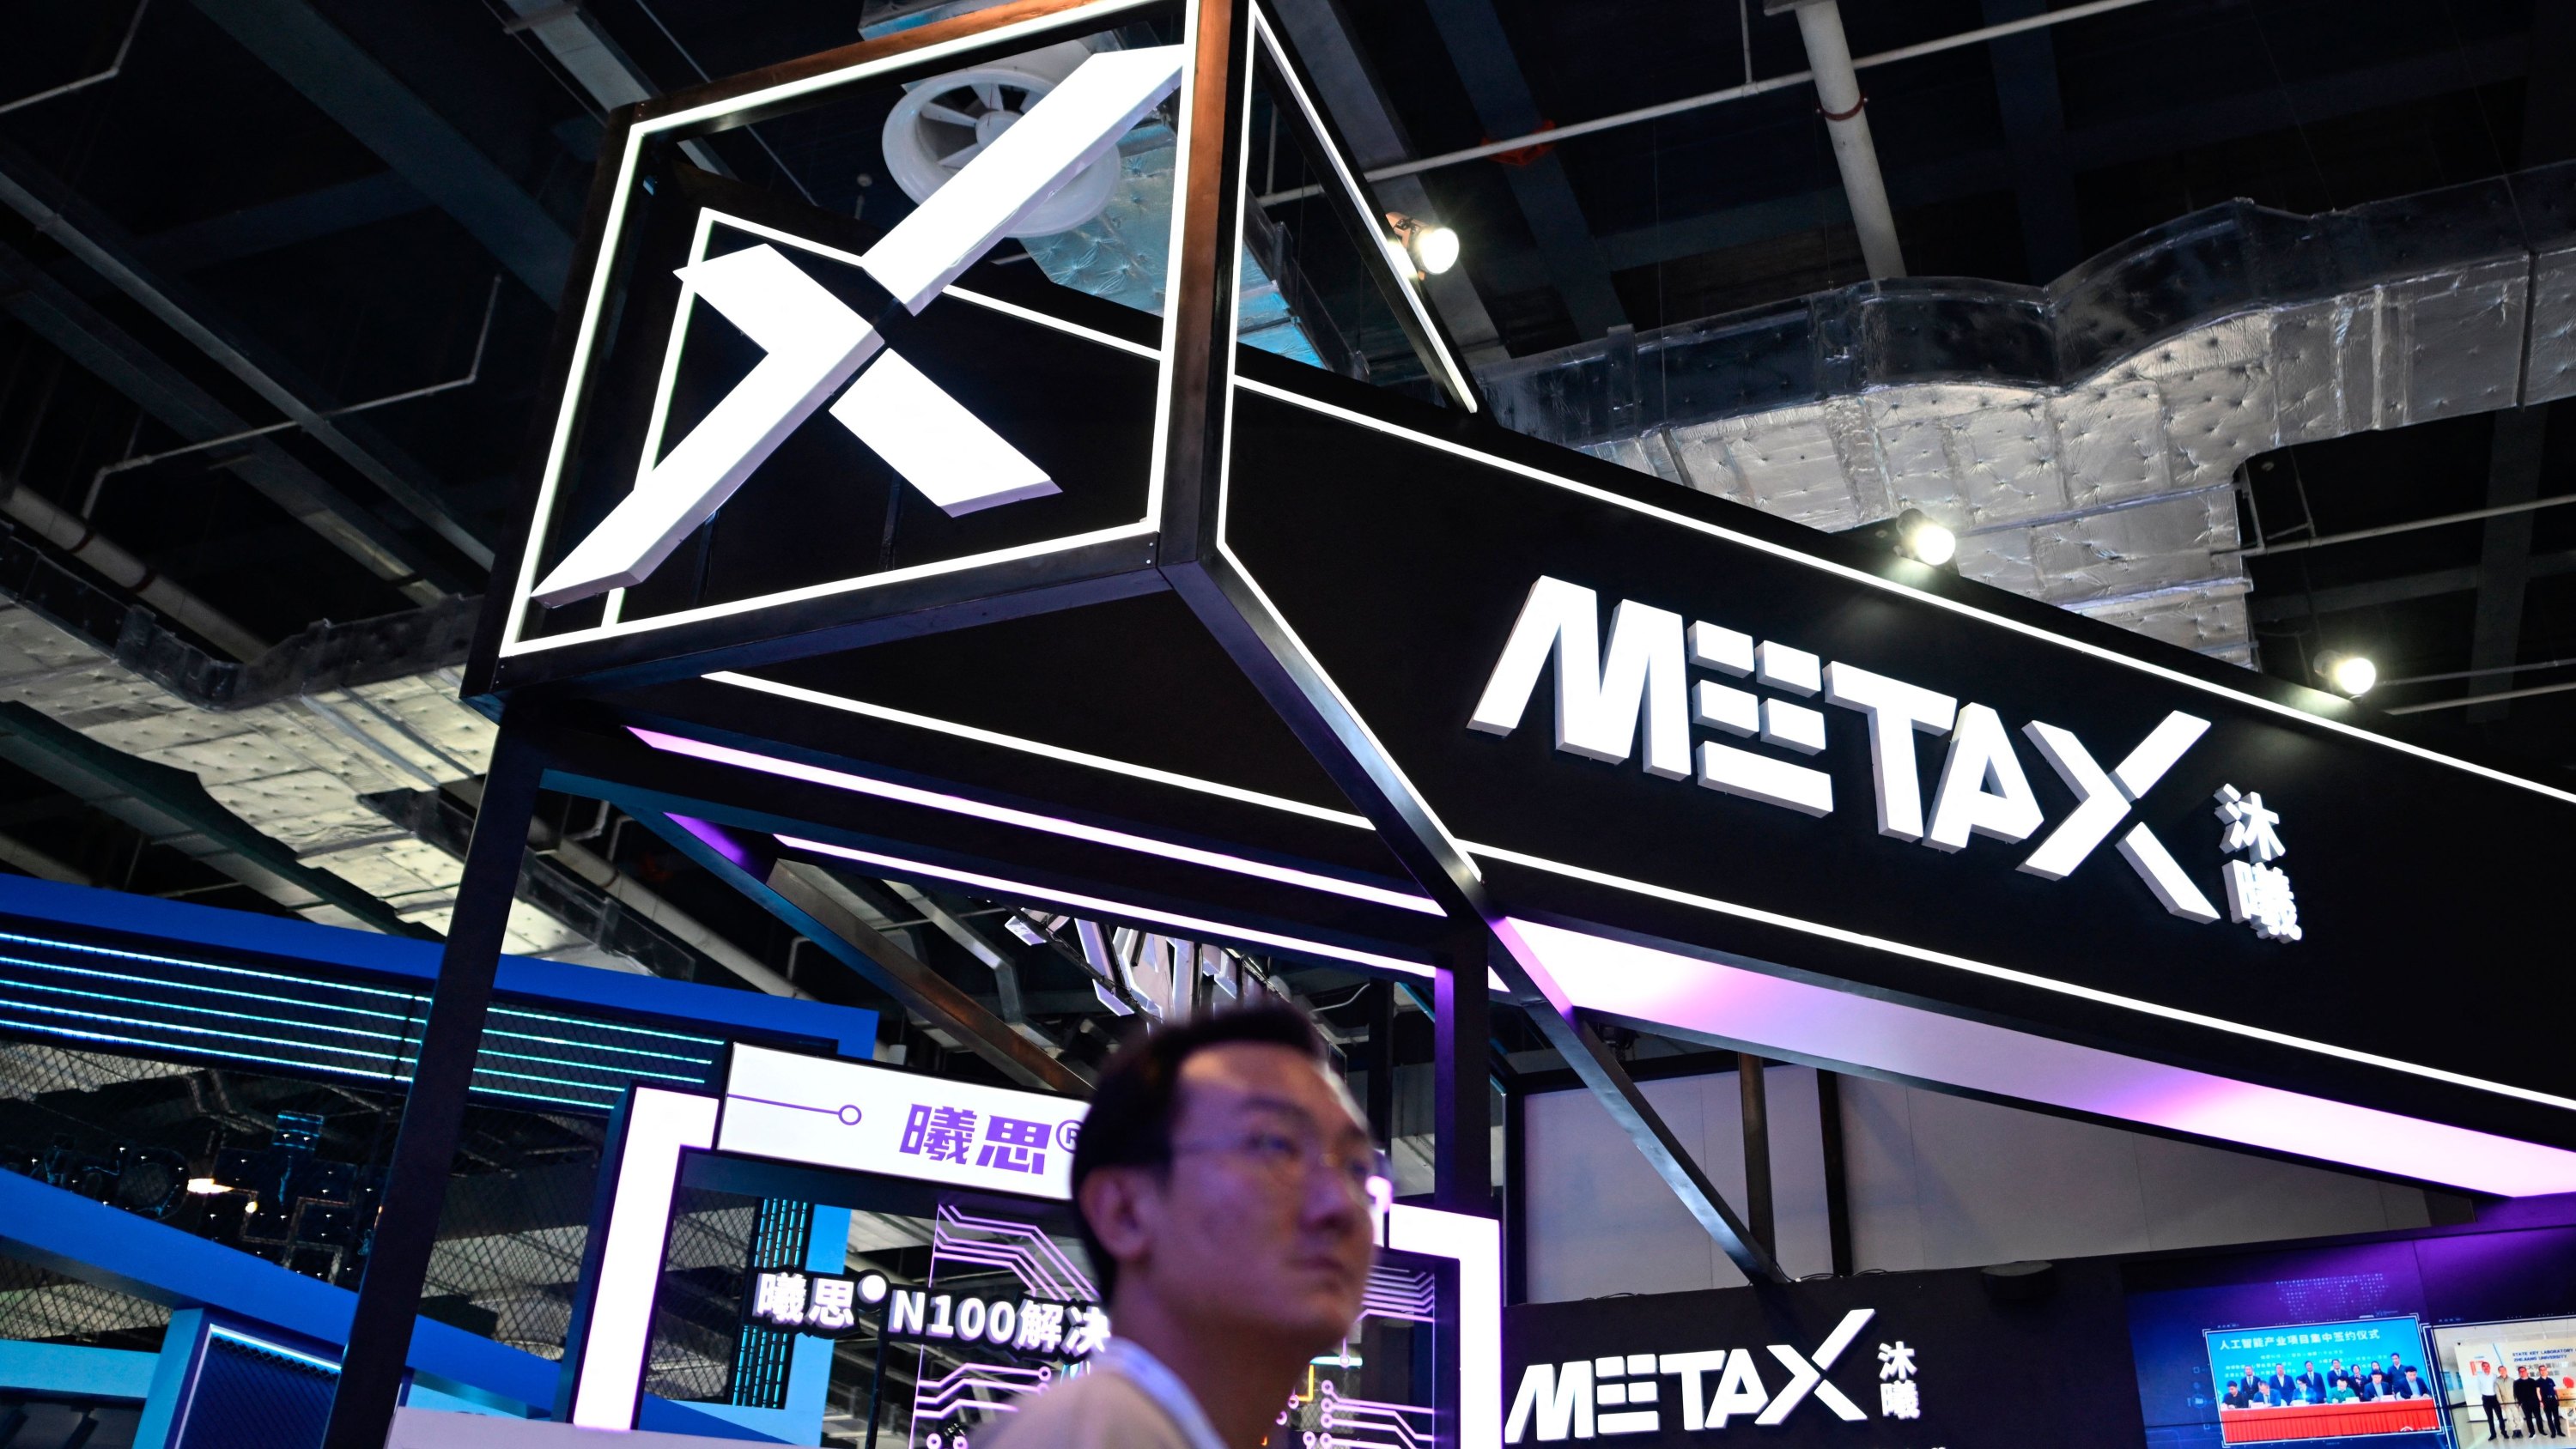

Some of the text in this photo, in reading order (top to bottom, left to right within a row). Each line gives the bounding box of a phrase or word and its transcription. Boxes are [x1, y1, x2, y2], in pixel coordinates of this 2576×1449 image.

[1467, 574, 2220, 924] METAX
[2213, 783, 2302, 943] 沐曦
[1504, 1308, 1875, 1444] METAX
[1877, 1341, 1921, 1419] 沐曦
[2220, 1329, 2380, 1350] 人工智能产业项目集中签约仪式
[2541, 1347, 2573, 1355] LABORATORY
